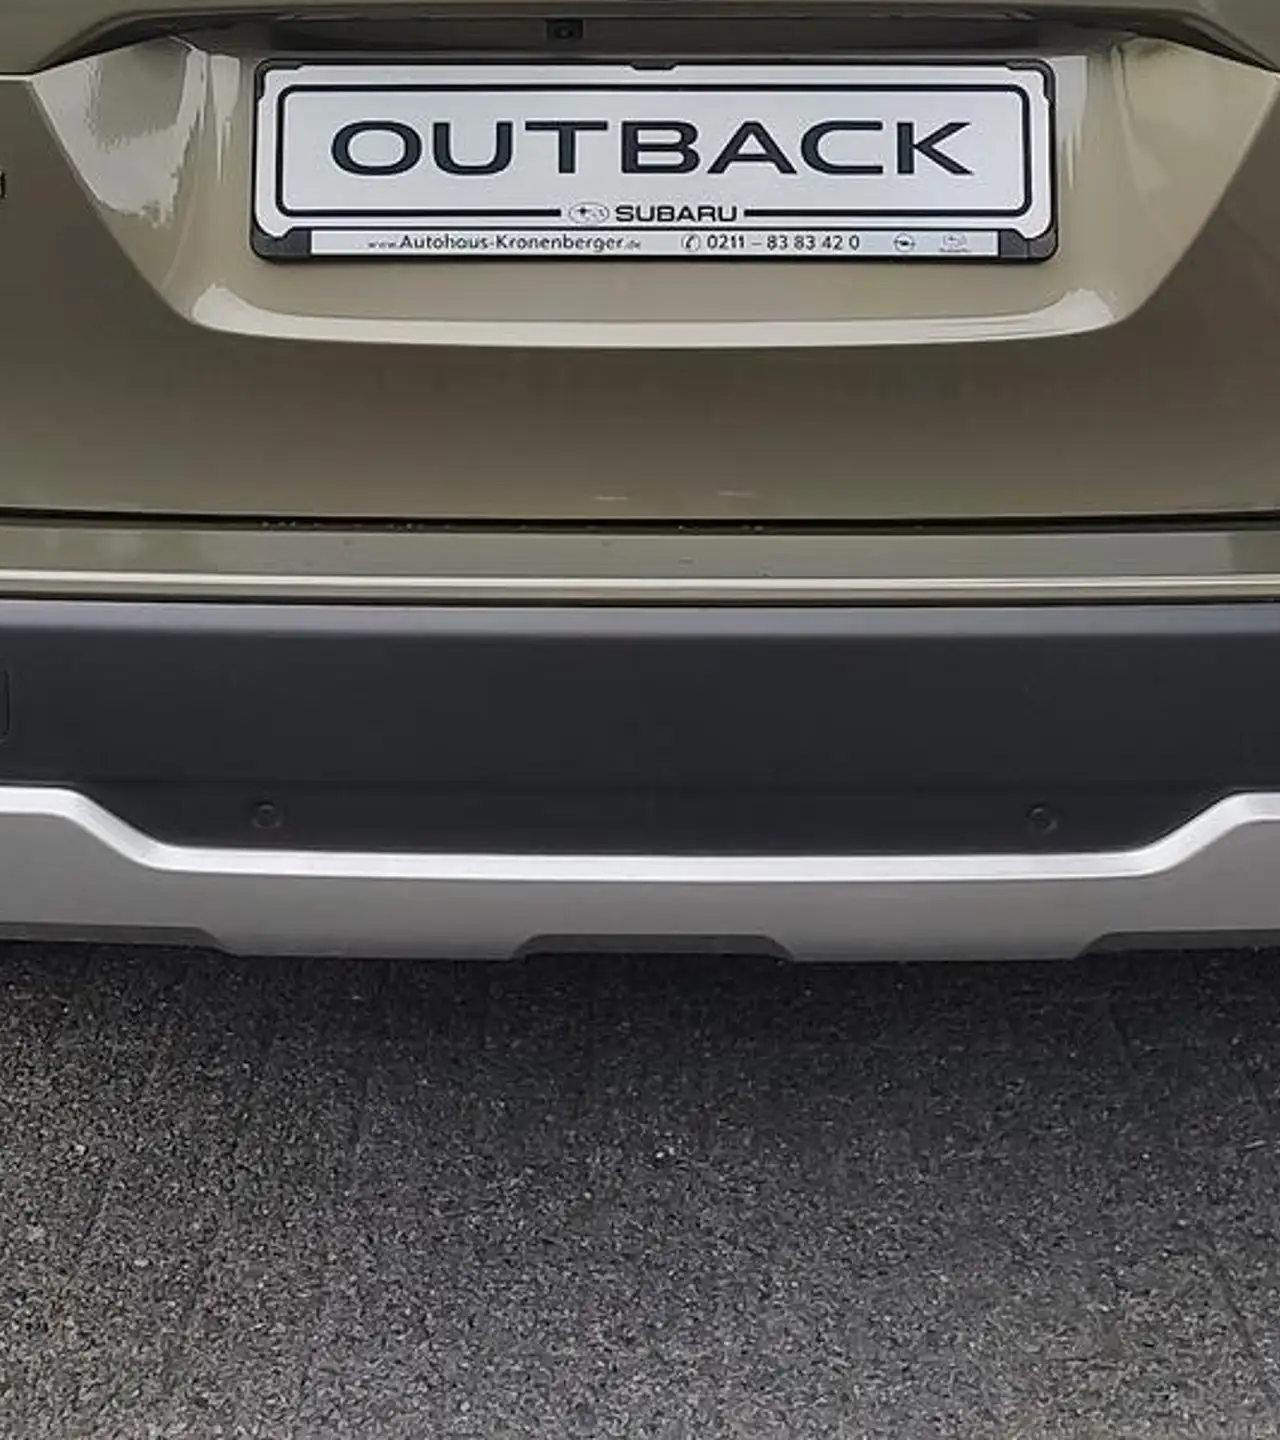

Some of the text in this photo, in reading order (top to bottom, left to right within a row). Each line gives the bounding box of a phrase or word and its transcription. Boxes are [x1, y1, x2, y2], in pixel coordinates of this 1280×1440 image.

[330, 118, 974, 177] OUTBACK
[615, 203, 737, 224] SUBARU
[706, 234, 746, 250] 0211
[766, 234, 789, 250] 83
[793, 234, 816, 250] 83
[821, 234, 844, 250] 42
[847, 234, 861, 250] 0
